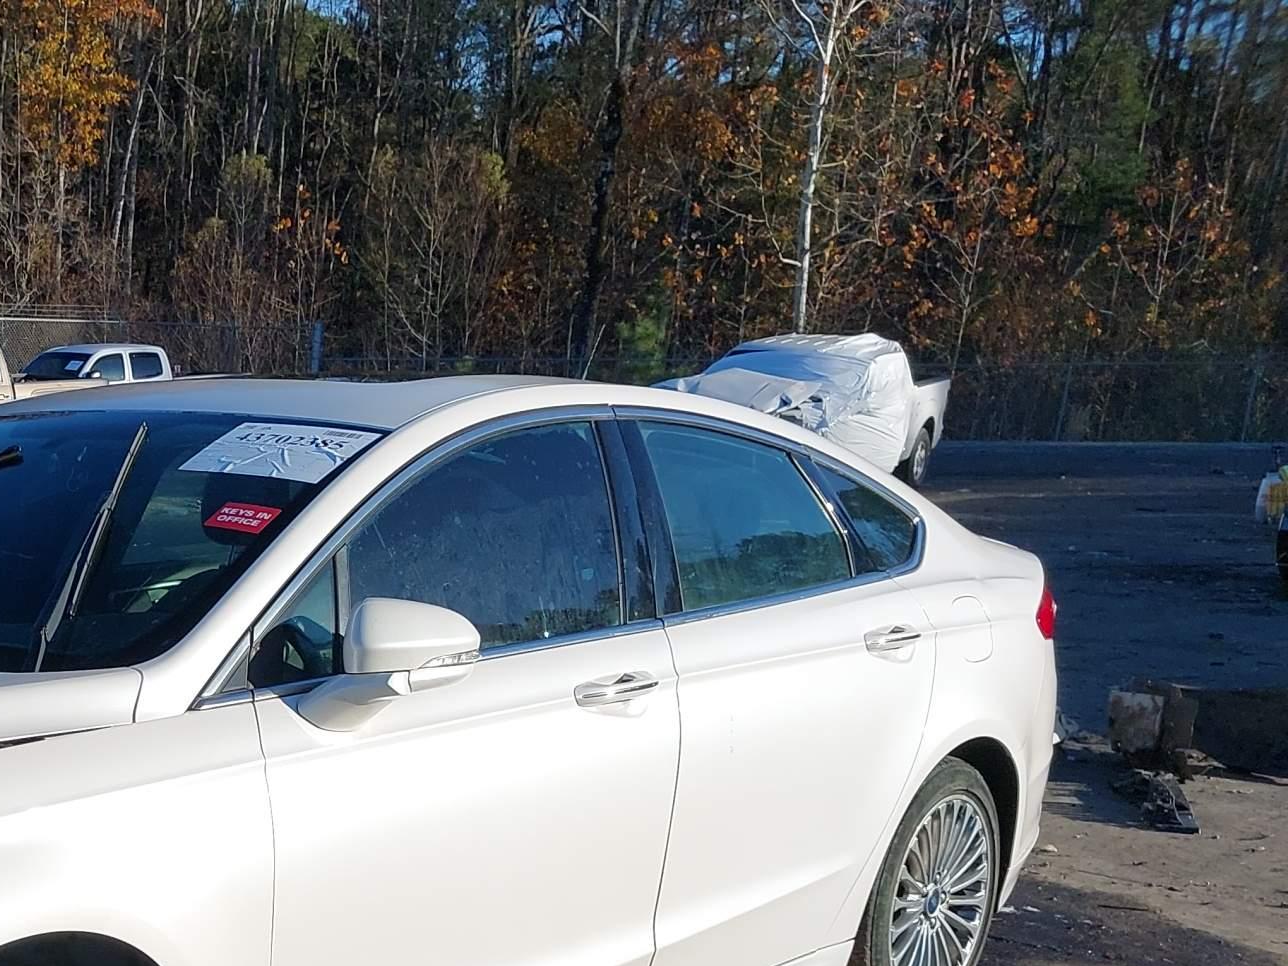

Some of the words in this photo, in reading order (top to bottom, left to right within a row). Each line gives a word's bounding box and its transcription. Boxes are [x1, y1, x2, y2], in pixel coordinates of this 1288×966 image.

[236, 432, 350, 449] 43702385
[220, 507, 256, 517] KEYS
[256, 511, 272, 520] IN
[216, 515, 262, 527] OFFICE
